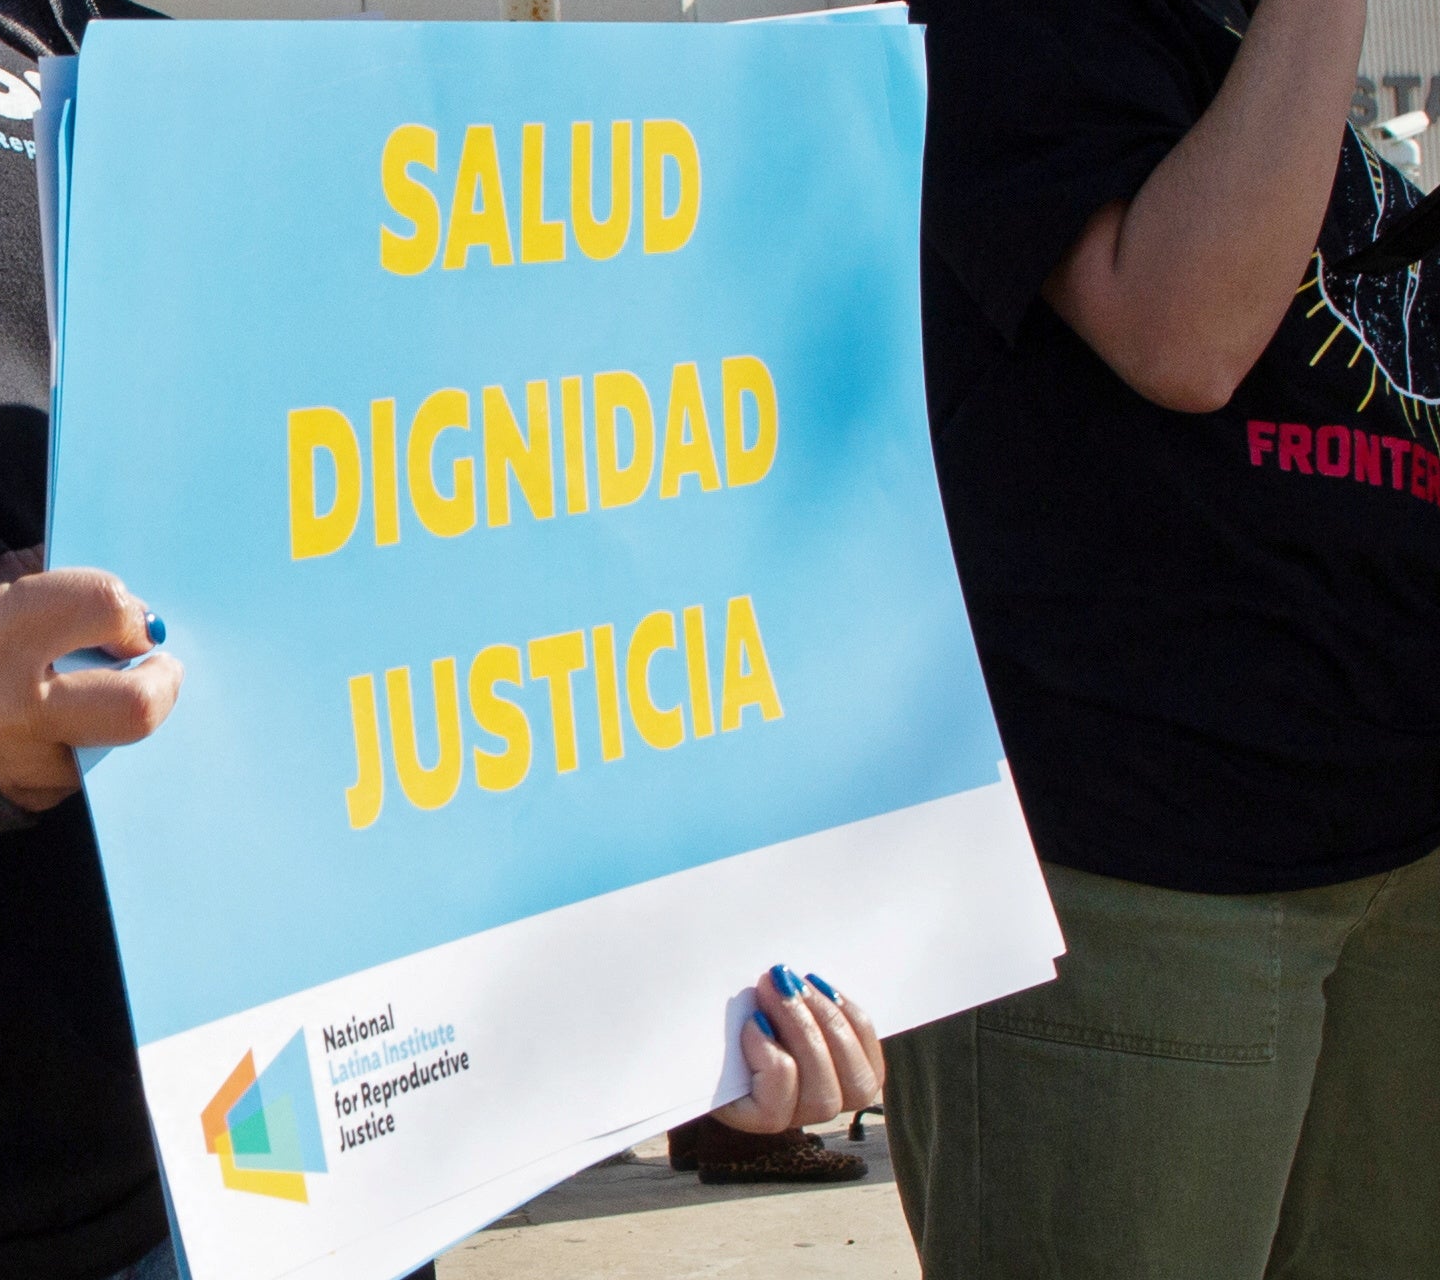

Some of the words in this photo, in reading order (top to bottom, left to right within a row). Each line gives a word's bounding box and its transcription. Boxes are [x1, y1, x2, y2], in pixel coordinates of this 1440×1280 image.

[378, 117, 703, 277] SALUD
[286, 353, 780, 562] DIGNIDAD
[343, 593, 786, 832] JUSTICIA
[323, 1003, 395, 1054] National
[328, 1046, 382, 1087] Latina
[381, 1023, 457, 1067] Institute
[334, 1090, 359, 1120] for
[360, 1049, 471, 1109] Reproductive
[339, 1111, 396, 1153] Justice
